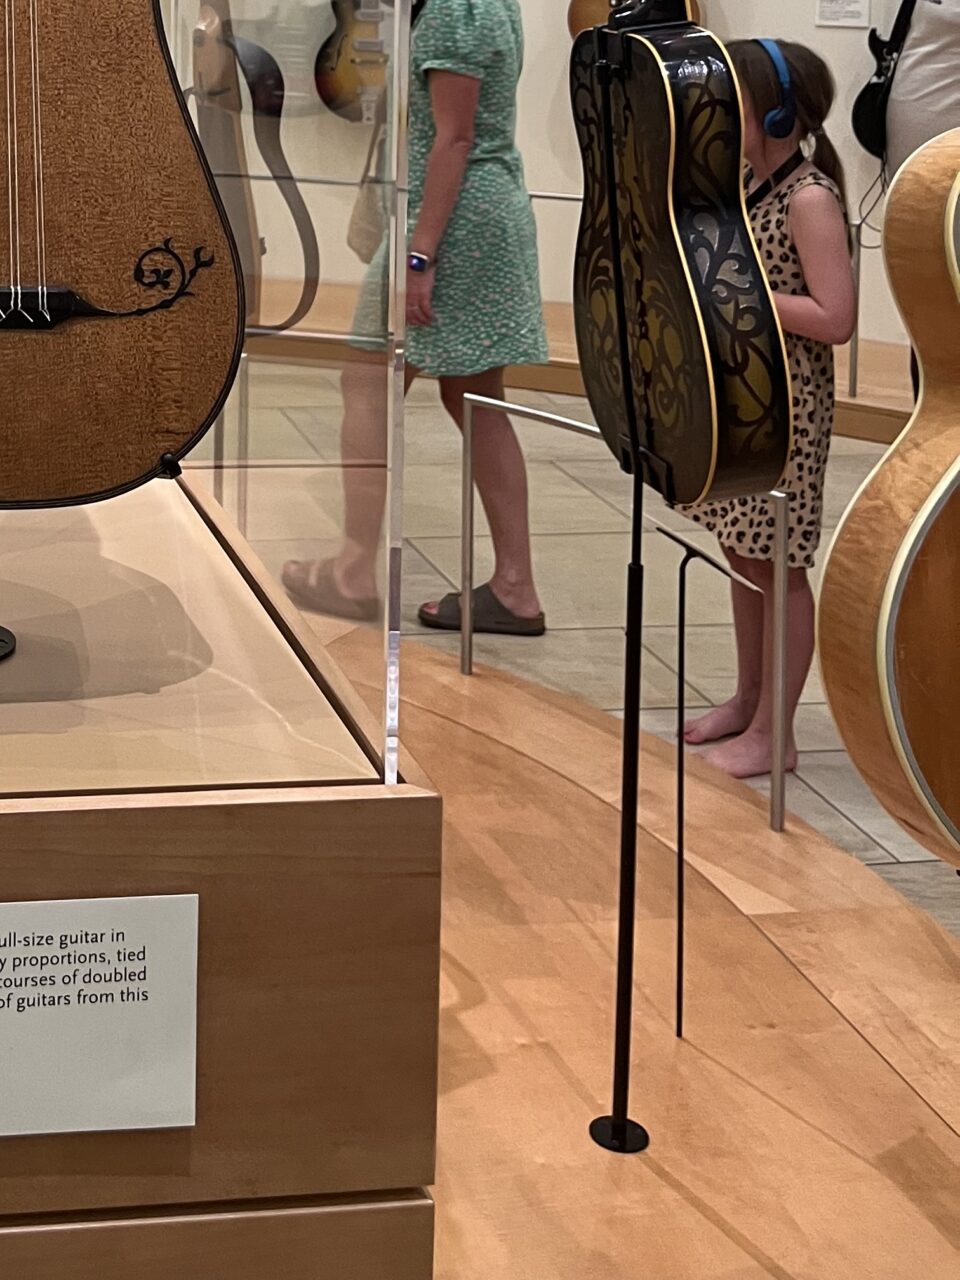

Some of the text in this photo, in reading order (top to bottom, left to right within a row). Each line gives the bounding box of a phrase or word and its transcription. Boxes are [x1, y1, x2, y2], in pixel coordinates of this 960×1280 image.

[60, 930, 105, 949] guitar
[112, 929, 124, 942] in
[13, 950, 110, 972] proportions,
[117, 946, 145, 962] tied
[62, 969, 79, 985] of
[83, 966, 146, 983] doubled
[17, 993, 70, 1012] guitars
[77, 989, 114, 1004] from
[120, 987, 148, 1002] this
